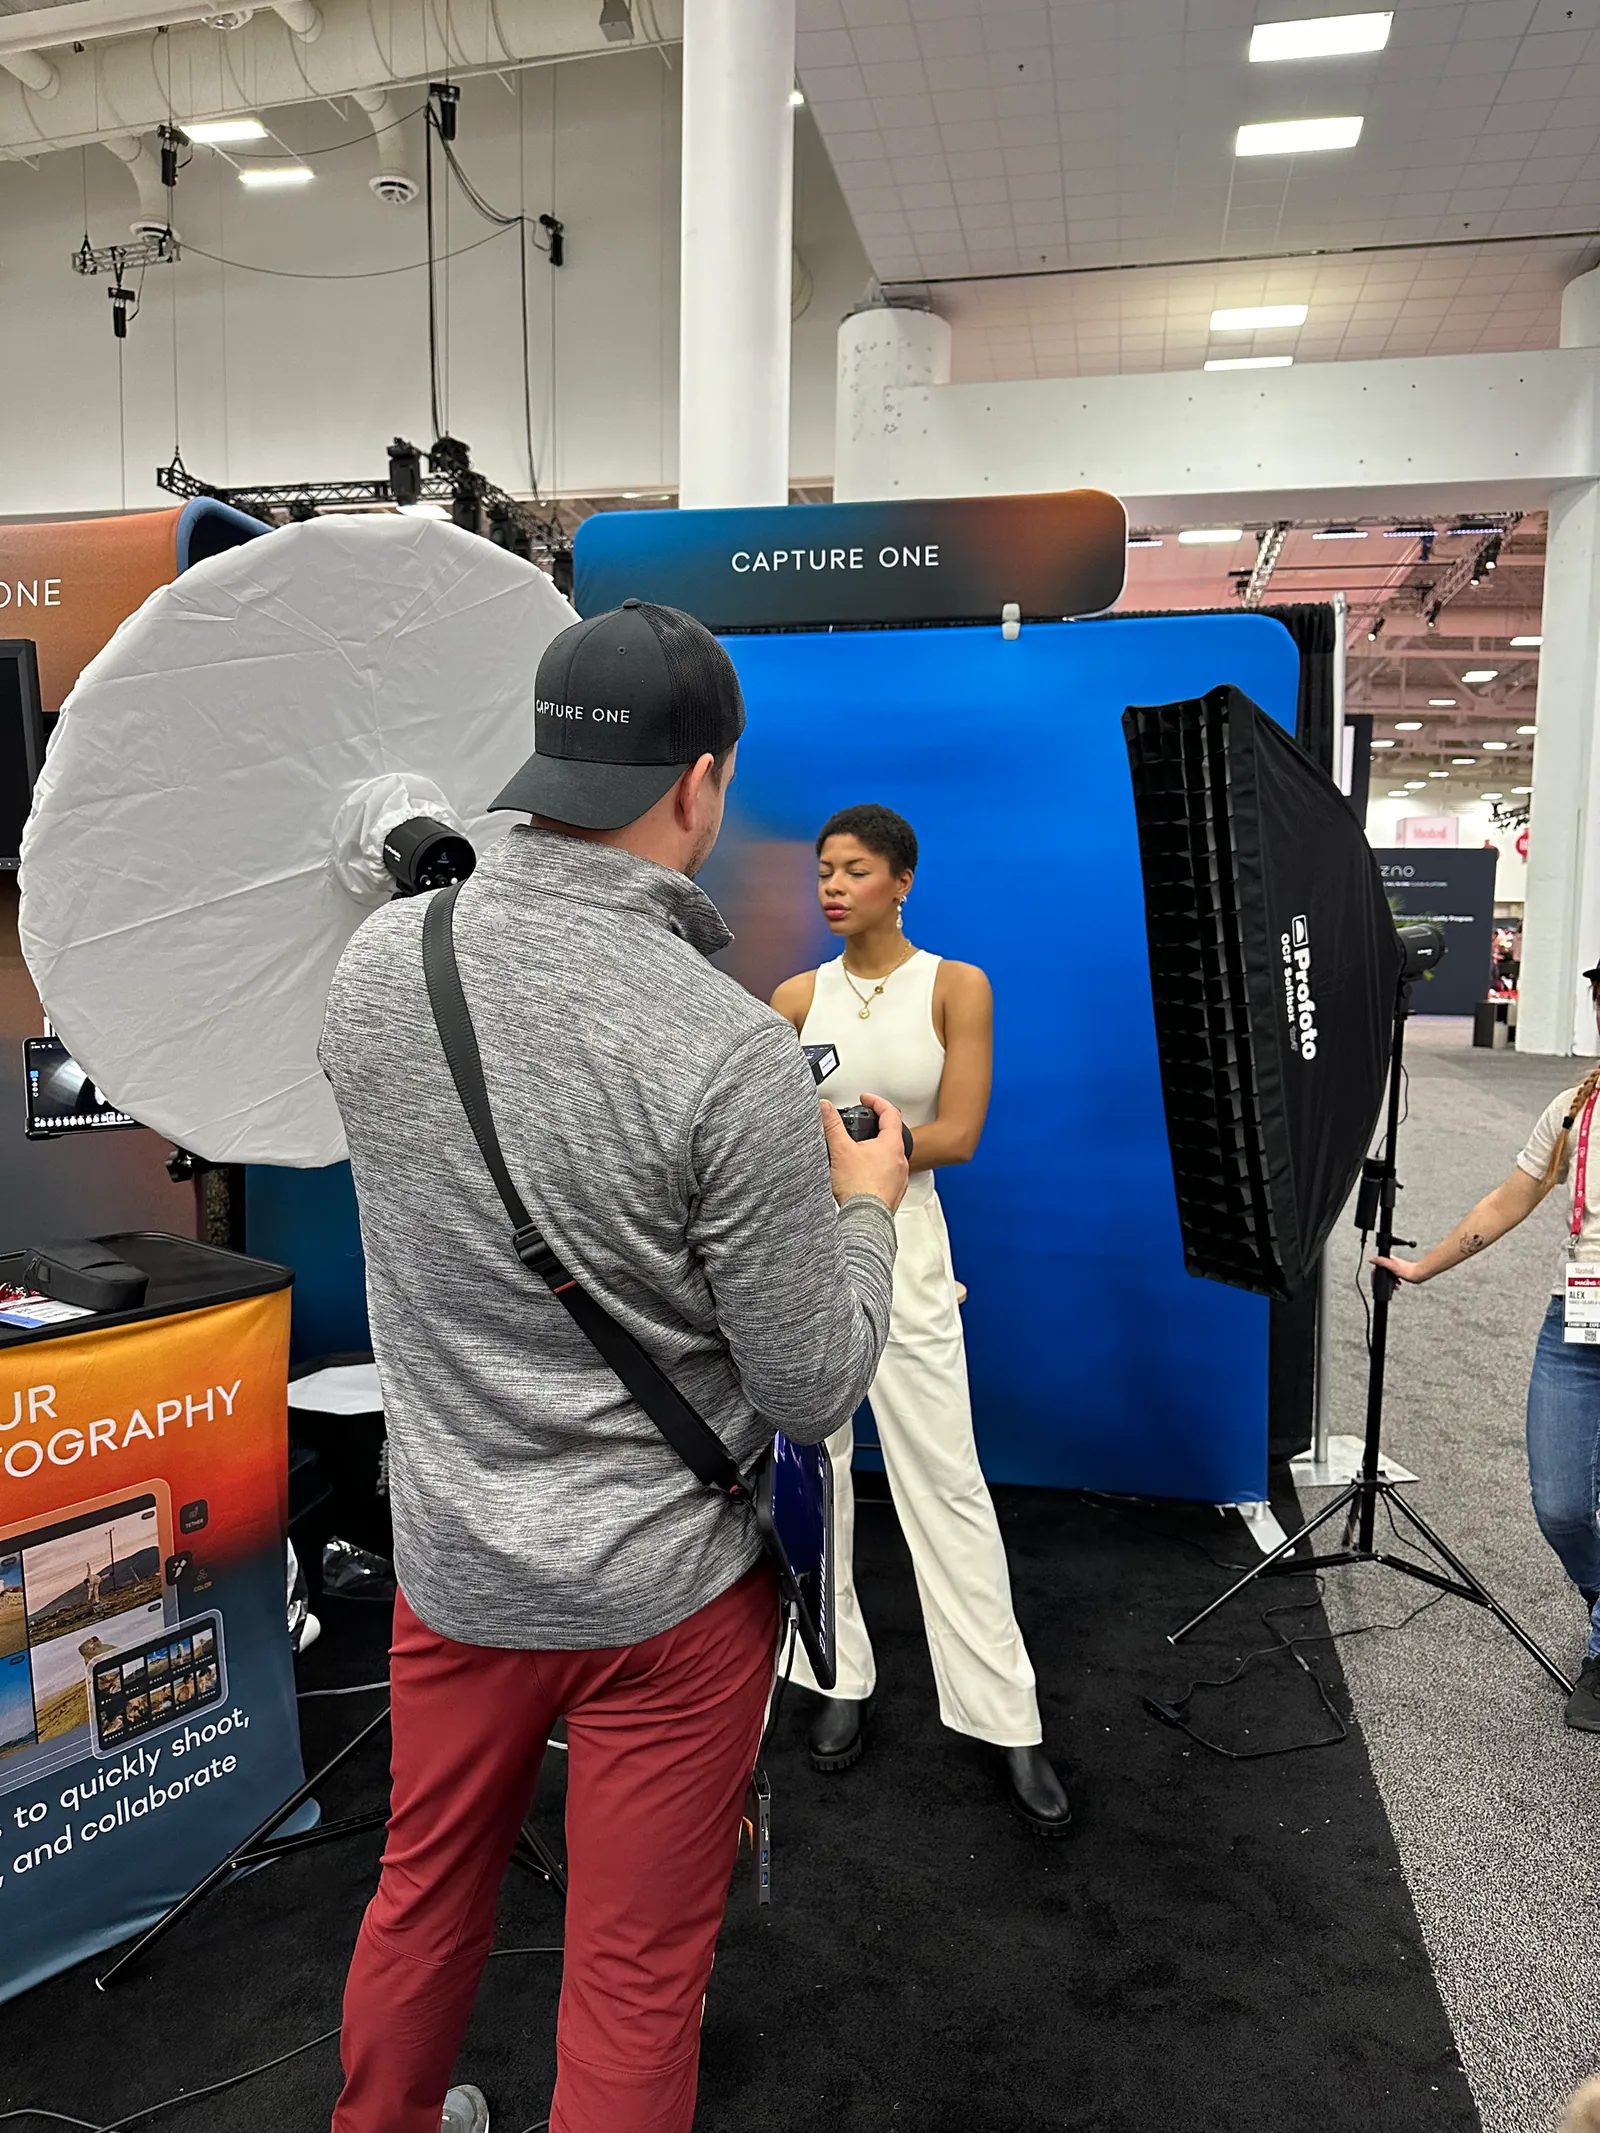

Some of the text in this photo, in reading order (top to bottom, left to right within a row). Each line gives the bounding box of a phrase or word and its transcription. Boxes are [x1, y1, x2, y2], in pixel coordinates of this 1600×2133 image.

[731, 545, 940, 573] CAPTURE ONE
[536, 699, 631, 723] CAPTURE ONE
[1281, 932, 1292, 964] OCF
[1284, 966, 1296, 1023] Softbox
[1294, 947, 1318, 1061] Profoto
[1568, 1290, 1585, 1299] ALEX
[0, 1379, 242, 1478] OGRAPHY
[184, 1517, 204, 1529] TETHER
[193, 1581, 213, 1593] COLOR
[13, 1707, 250, 1829] to quickly shoot,
[12, 1754, 237, 1874] and collaborate
